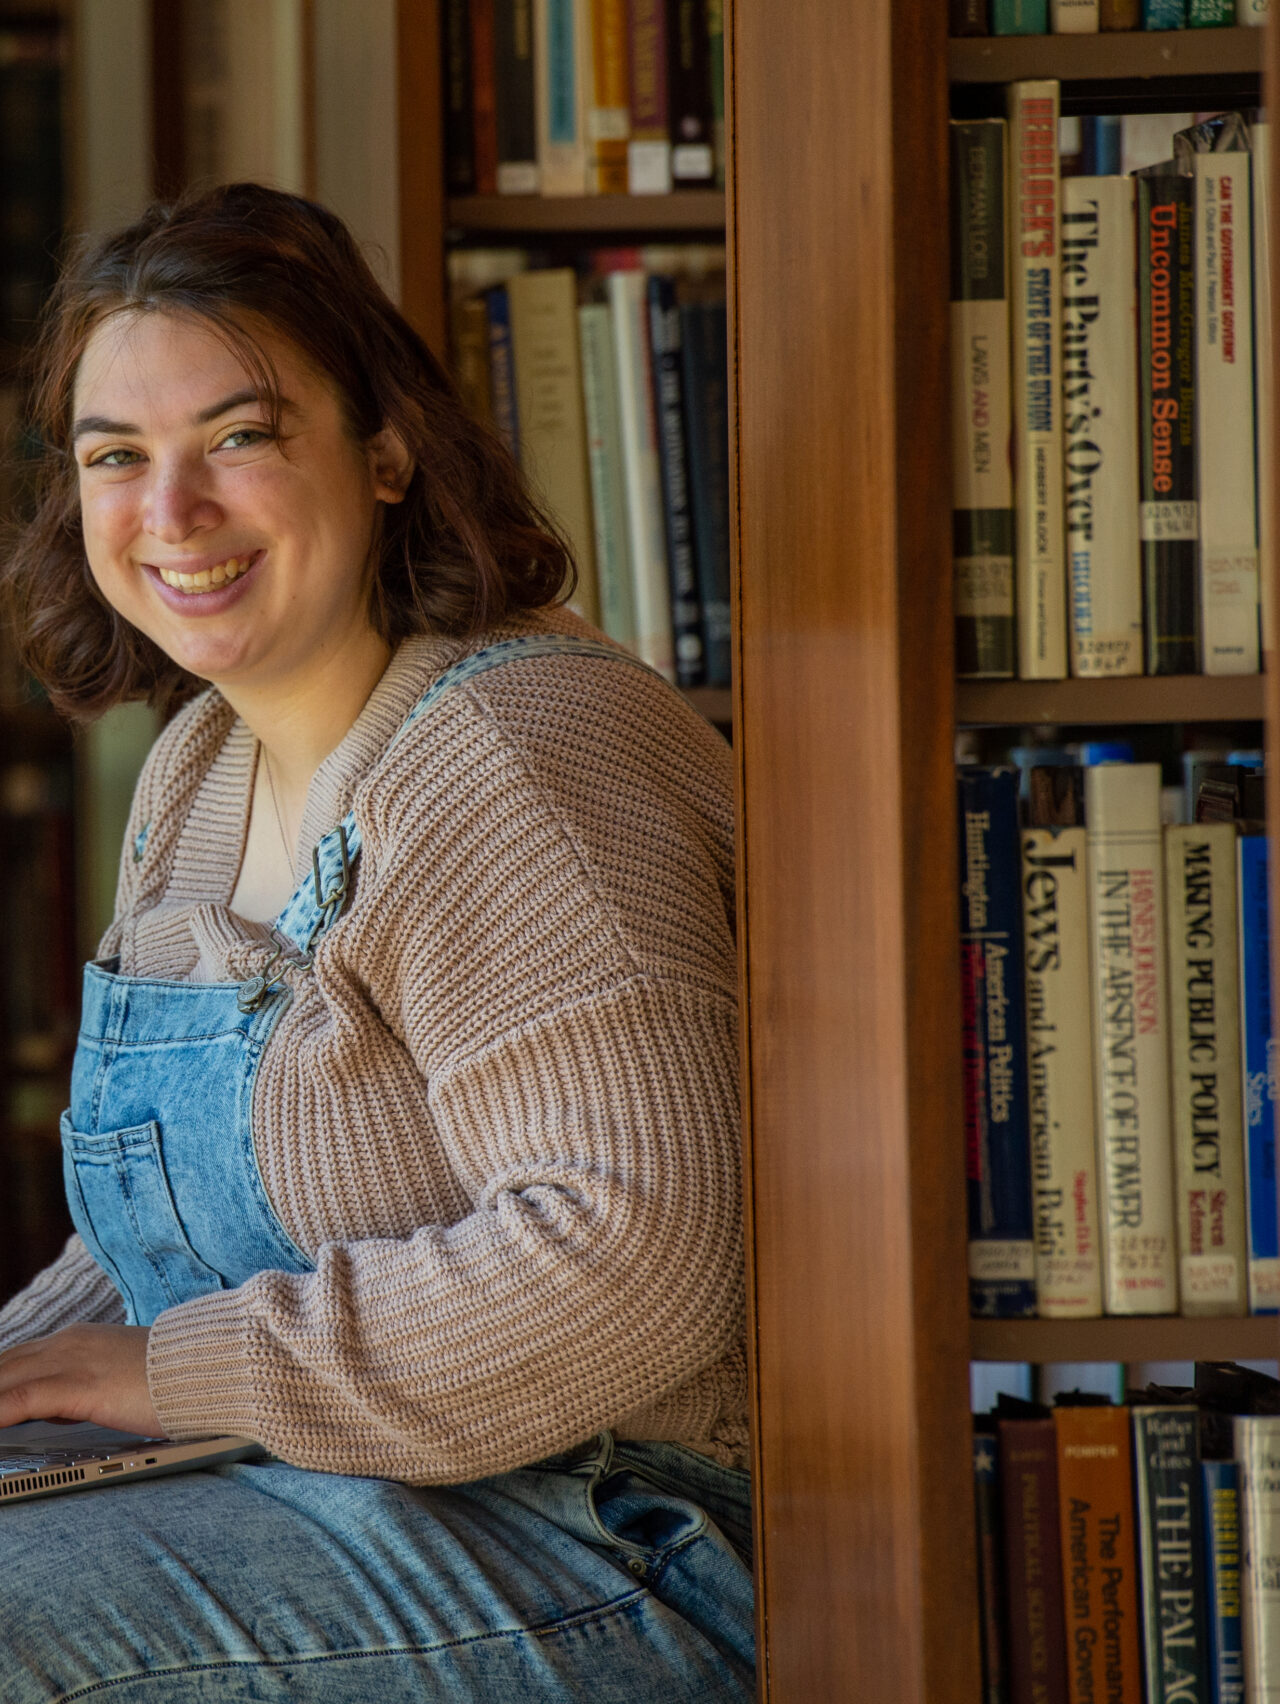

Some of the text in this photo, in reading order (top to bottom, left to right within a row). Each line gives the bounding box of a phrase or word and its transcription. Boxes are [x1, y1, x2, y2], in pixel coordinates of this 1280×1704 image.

[1022, 98, 1055, 258] HERBLOCK'S
[1178, 270, 1194, 382] MacGregor
[1220, 177, 1235, 364] CAN THE GOVERNMENT GOVERN?
[970, 335, 990, 473] LAWS AND MEN
[1026, 268, 1052, 432] STATE OF THE UNION
[1063, 200, 1103, 541] The Party's Over
[1150, 203, 1178, 493] Uncommon Sense
[1181, 387, 1194, 446] Burns
[1036, 511, 1048, 555] BLOCK
[962, 811, 991, 929] Huntington
[1097, 869, 1128, 900] IN
[1098, 904, 1132, 957] THE
[1131, 868, 1159, 1035] HAYNES JOHNSON
[1183, 841, 1221, 1179] MAKING PUBLIC POLICY
[984, 943, 1014, 1124] American Politics
[1024, 838, 1076, 1257] Jews and American Politi
[1101, 965, 1136, 1085] ABSENCE
[1109, 1091, 1138, 1127] OF
[1247, 1071, 1264, 1127] States
[1112, 1136, 1142, 1230] POWER
[1209, 1189, 1227, 1246] Steven
[1069, 1497, 1093, 1618] American
[1099, 1514, 1125, 1704] The Performan
[1156, 1482, 1198, 1704] THE PALAC
